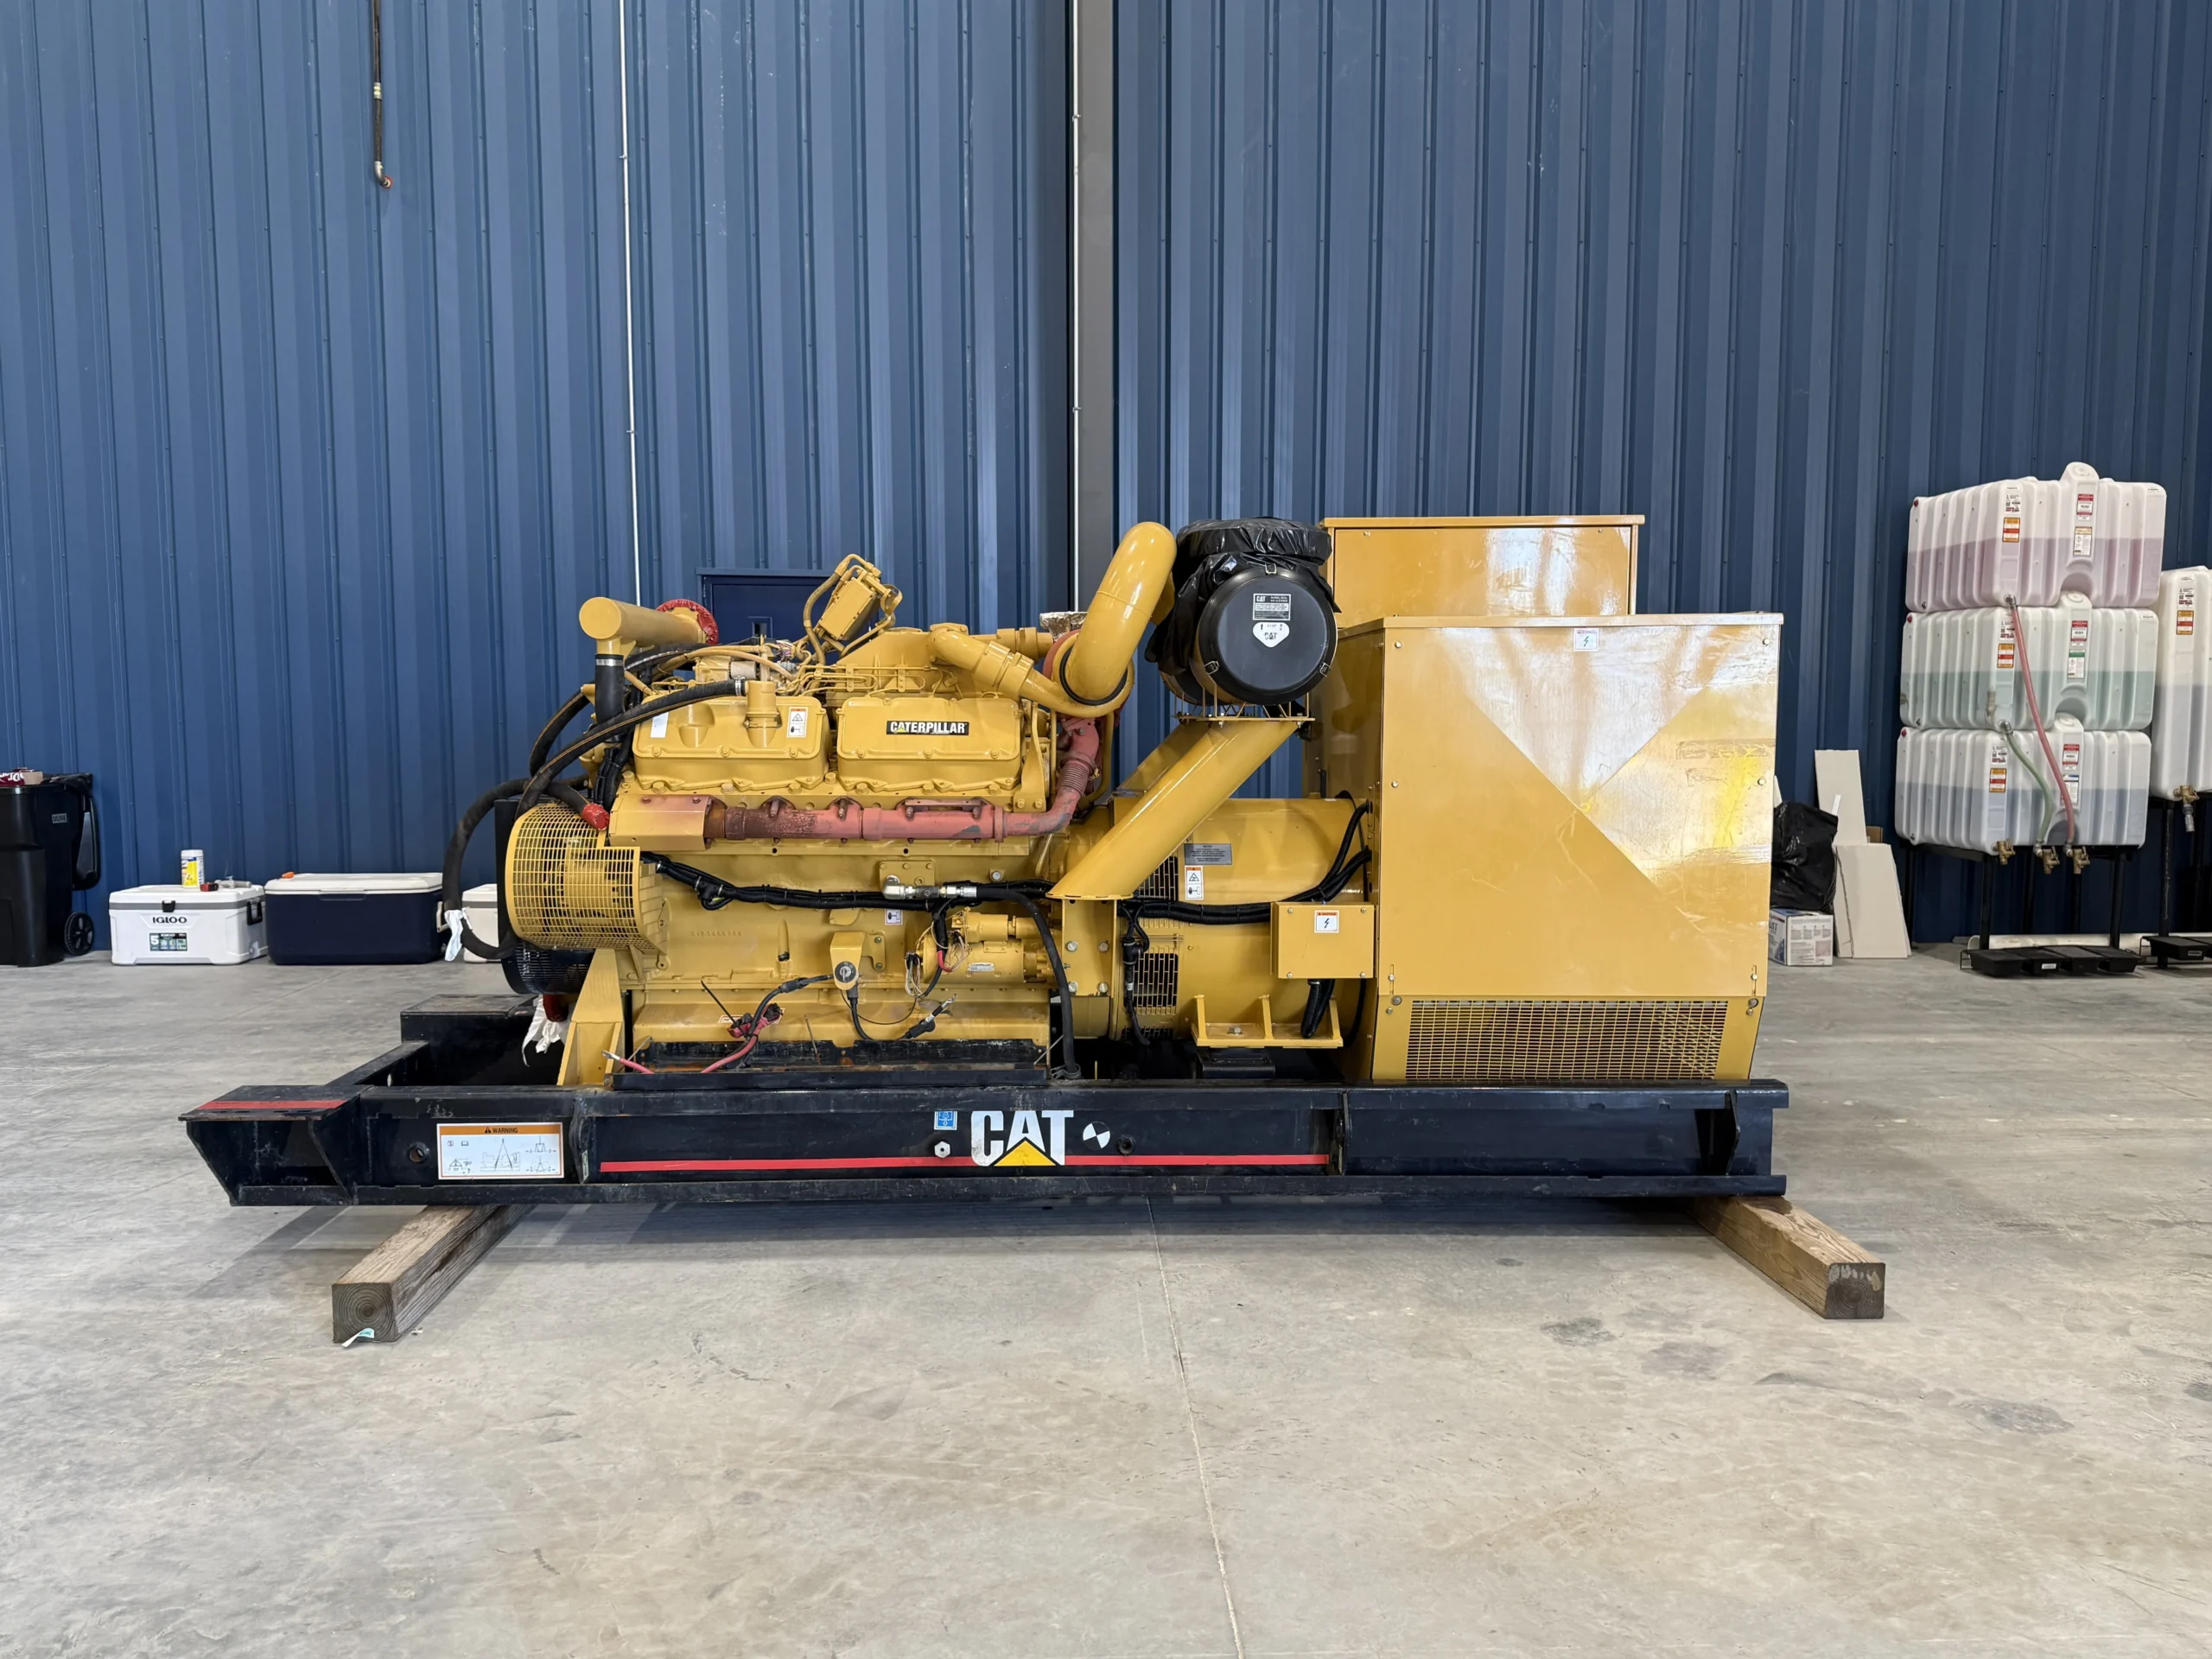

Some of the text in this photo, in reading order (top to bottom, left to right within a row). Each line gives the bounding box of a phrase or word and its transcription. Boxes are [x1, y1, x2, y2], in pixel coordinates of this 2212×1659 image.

[1264, 632, 1277, 640] CAT
[890, 721, 965, 734] CATERPILLAR
[150, 935, 159, 945] 5
[970, 1109, 1074, 1166] CAT
